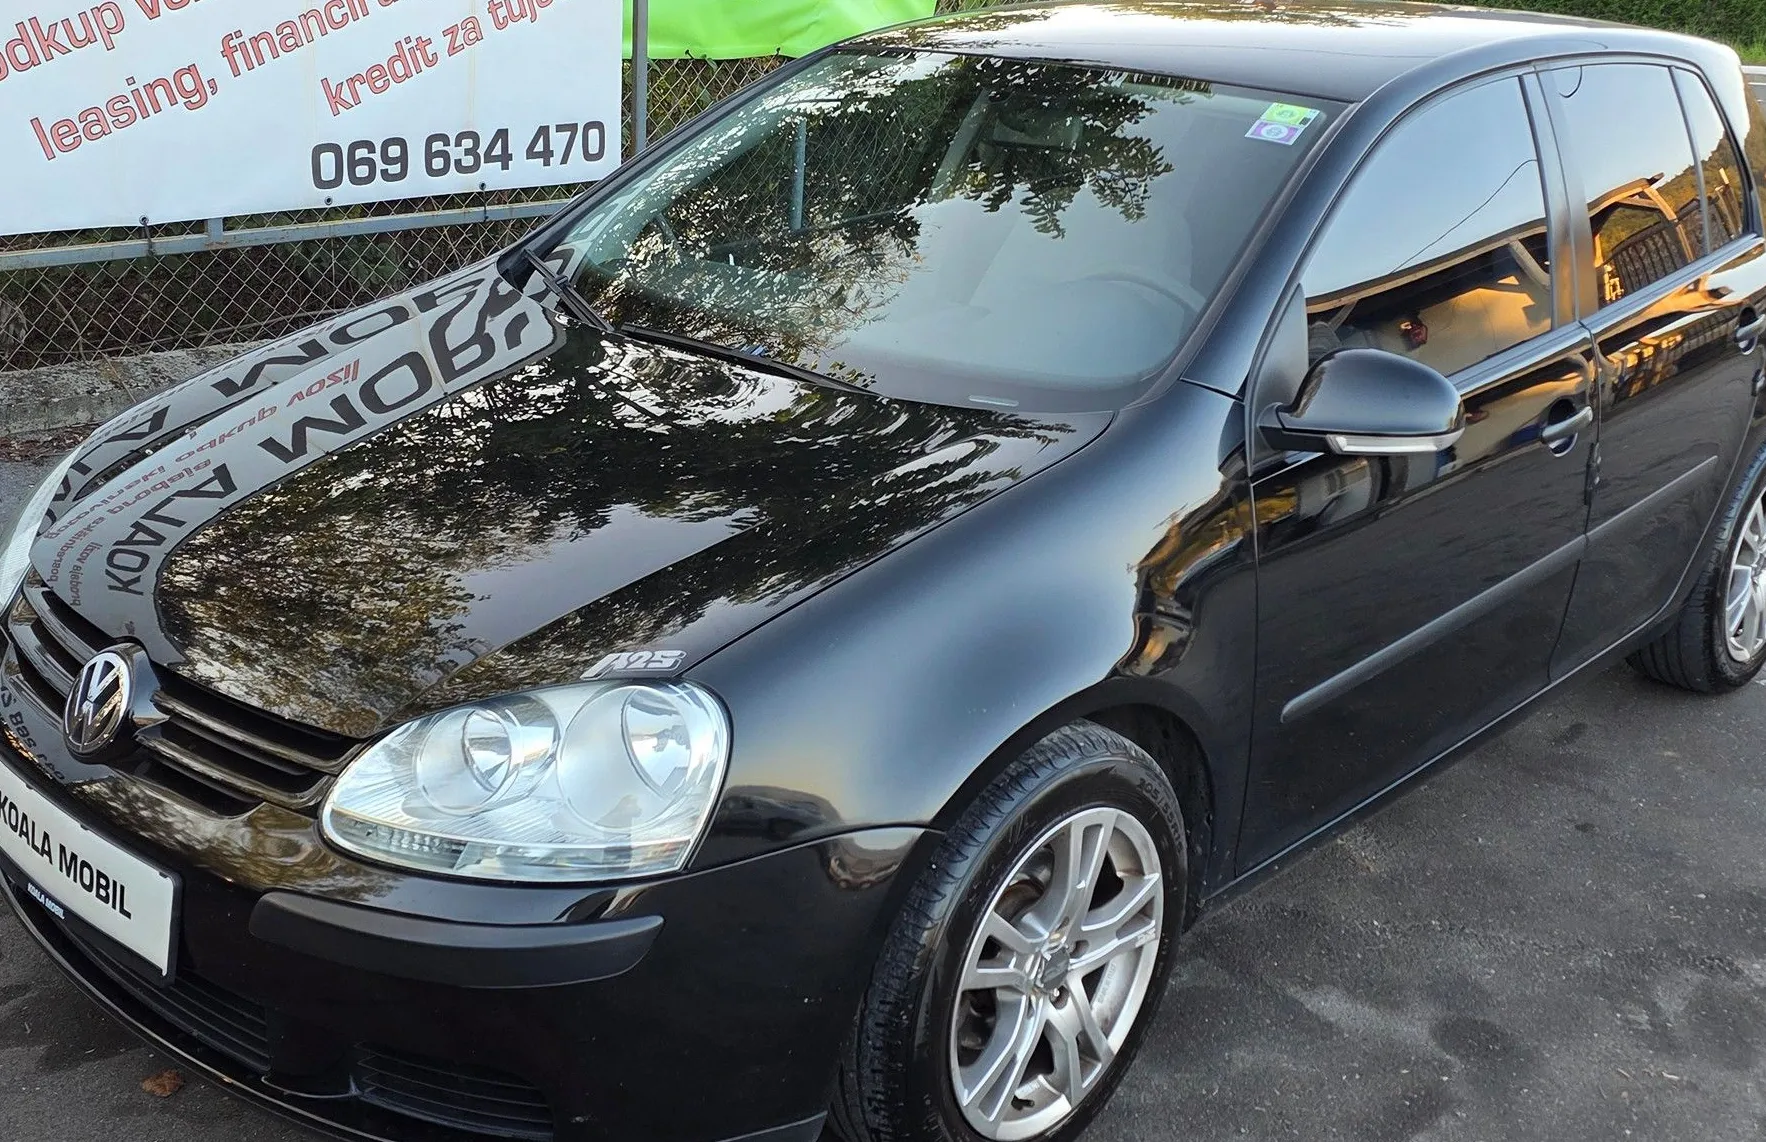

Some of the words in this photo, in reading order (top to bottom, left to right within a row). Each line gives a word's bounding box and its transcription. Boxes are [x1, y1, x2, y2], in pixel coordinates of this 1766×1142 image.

[321, 36, 439, 117] kredit
[442, 15, 484, 57] za
[488, 0, 556, 31] tuj
[30, 64, 218, 161] leasing,
[311, 142, 409, 190] 069
[424, 128, 513, 178] 634
[525, 120, 606, 167] 470
[0, 789, 54, 866] KOALA
[59, 842, 132, 920] MOBIL
